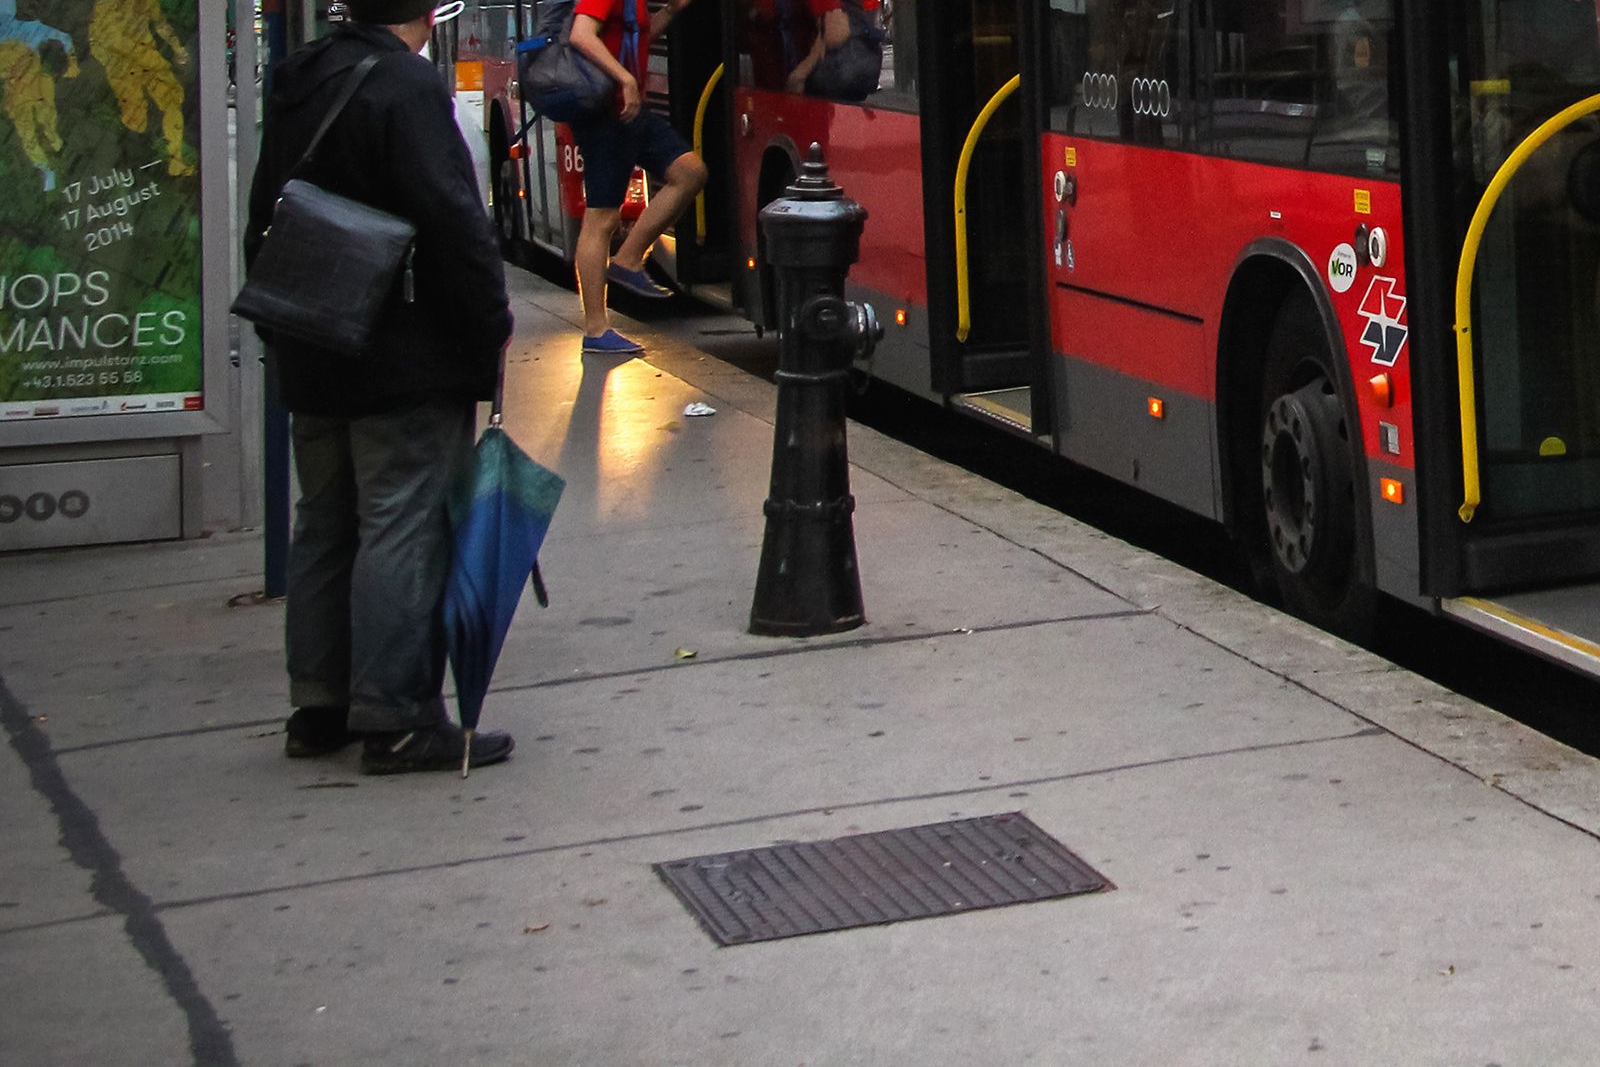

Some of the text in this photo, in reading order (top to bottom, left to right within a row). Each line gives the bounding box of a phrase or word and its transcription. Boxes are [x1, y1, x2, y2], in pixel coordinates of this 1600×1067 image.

[62, 181, 82, 204] 17
[88, 168, 135, 196] July
[60, 182, 161, 231] 17 August
[84, 220, 134, 252] 2014
[1331, 257, 1353, 277] VOR
